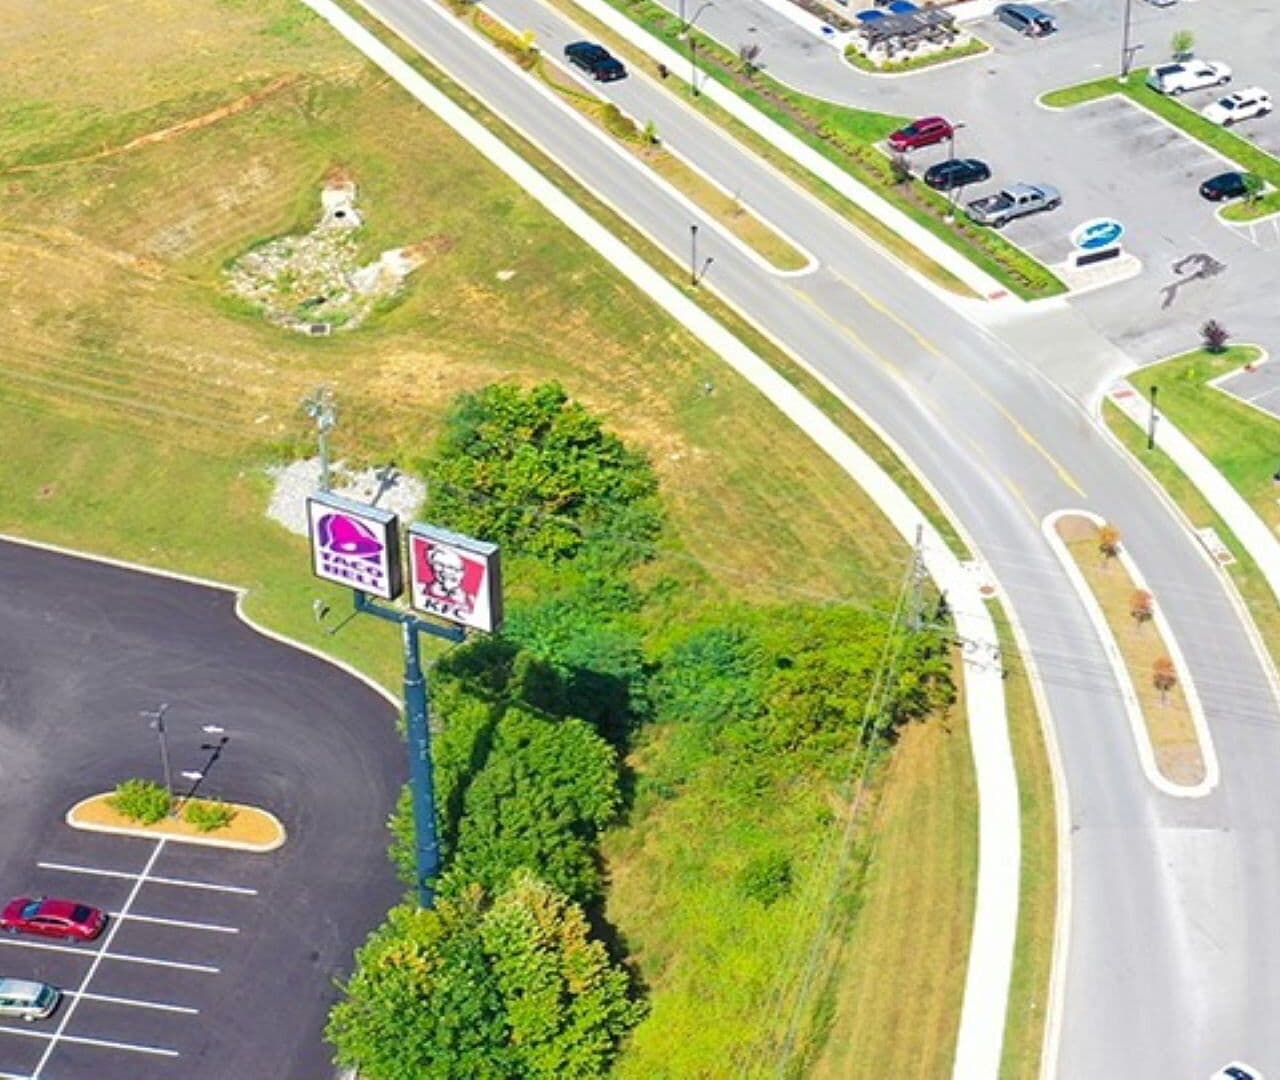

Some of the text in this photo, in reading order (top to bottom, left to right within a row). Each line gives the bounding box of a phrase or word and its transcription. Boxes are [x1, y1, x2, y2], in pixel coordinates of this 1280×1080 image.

[319, 550, 383, 578] TACO
[322, 563, 385, 590] BELL
[424, 599, 466, 620] KFC
